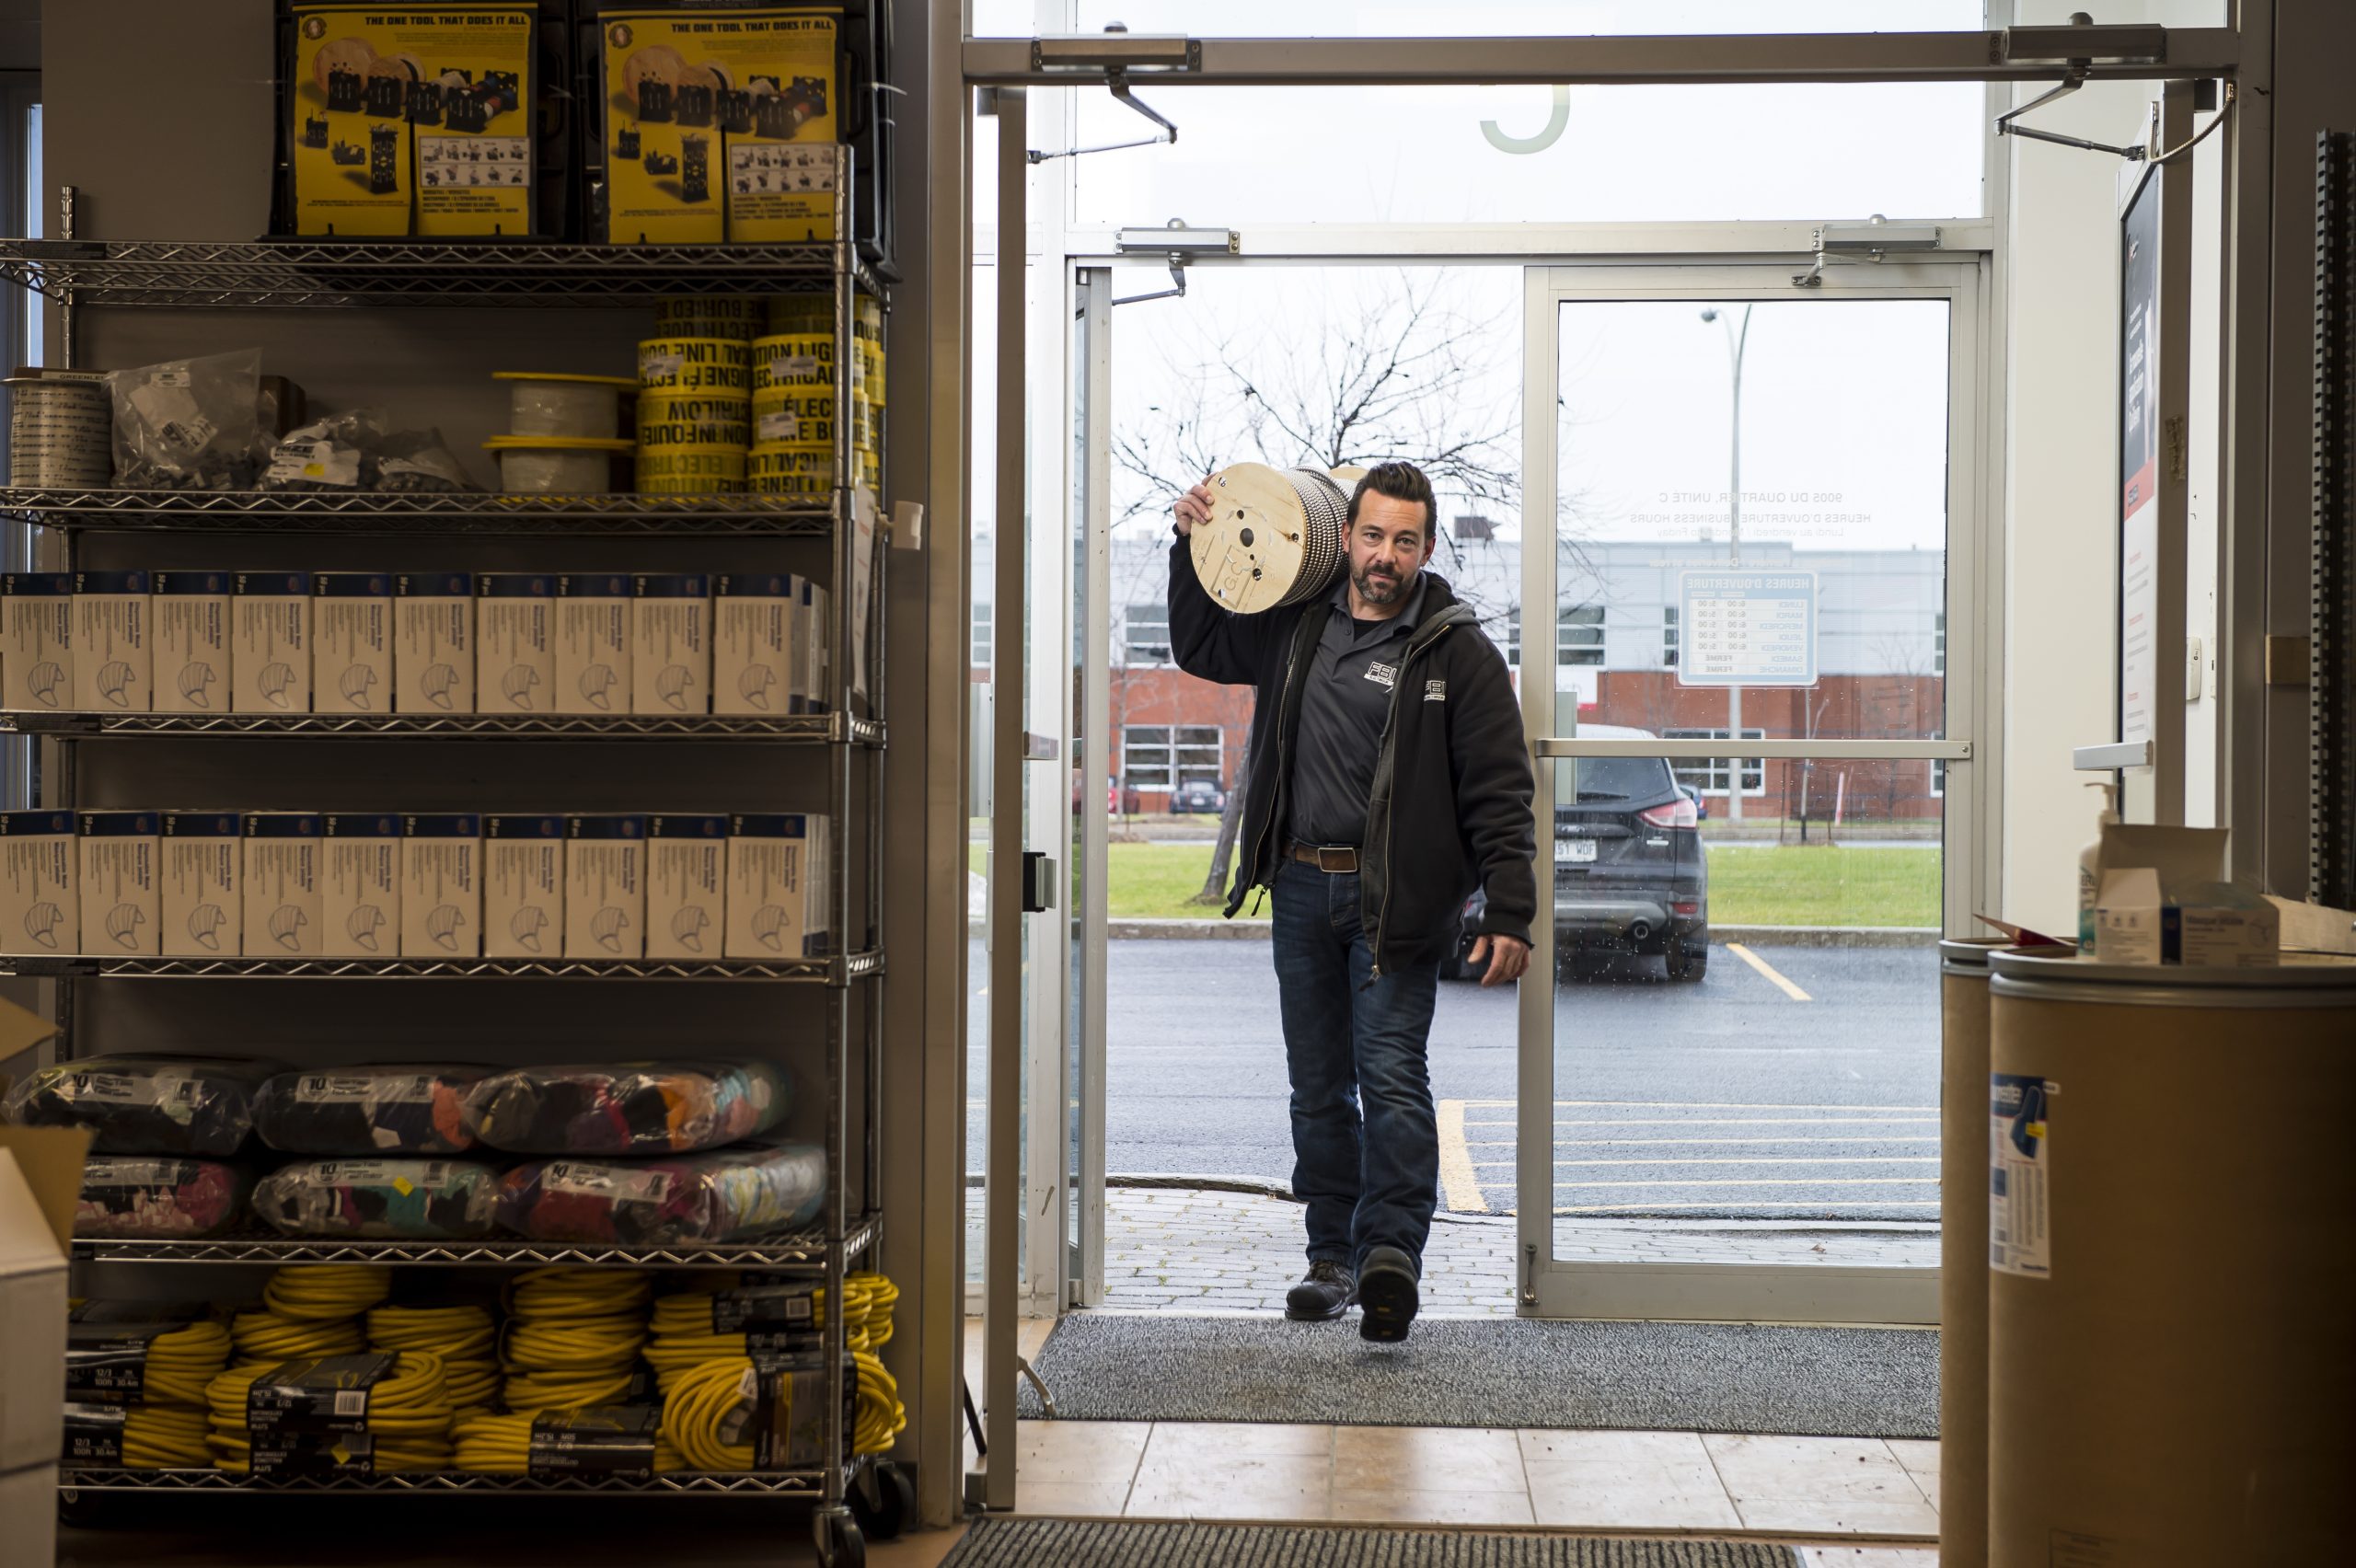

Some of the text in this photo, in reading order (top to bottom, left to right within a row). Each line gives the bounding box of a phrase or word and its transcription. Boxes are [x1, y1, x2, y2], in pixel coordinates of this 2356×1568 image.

[365, 16, 526, 25] THE ONE TOOL THAT DOES IT ALL
[672, 21, 832, 33] THE ONE TOOL THAT DOES IT ALL
[1368, 662, 1397, 682] FBI
[95, 1368, 112, 1377] 12/3
